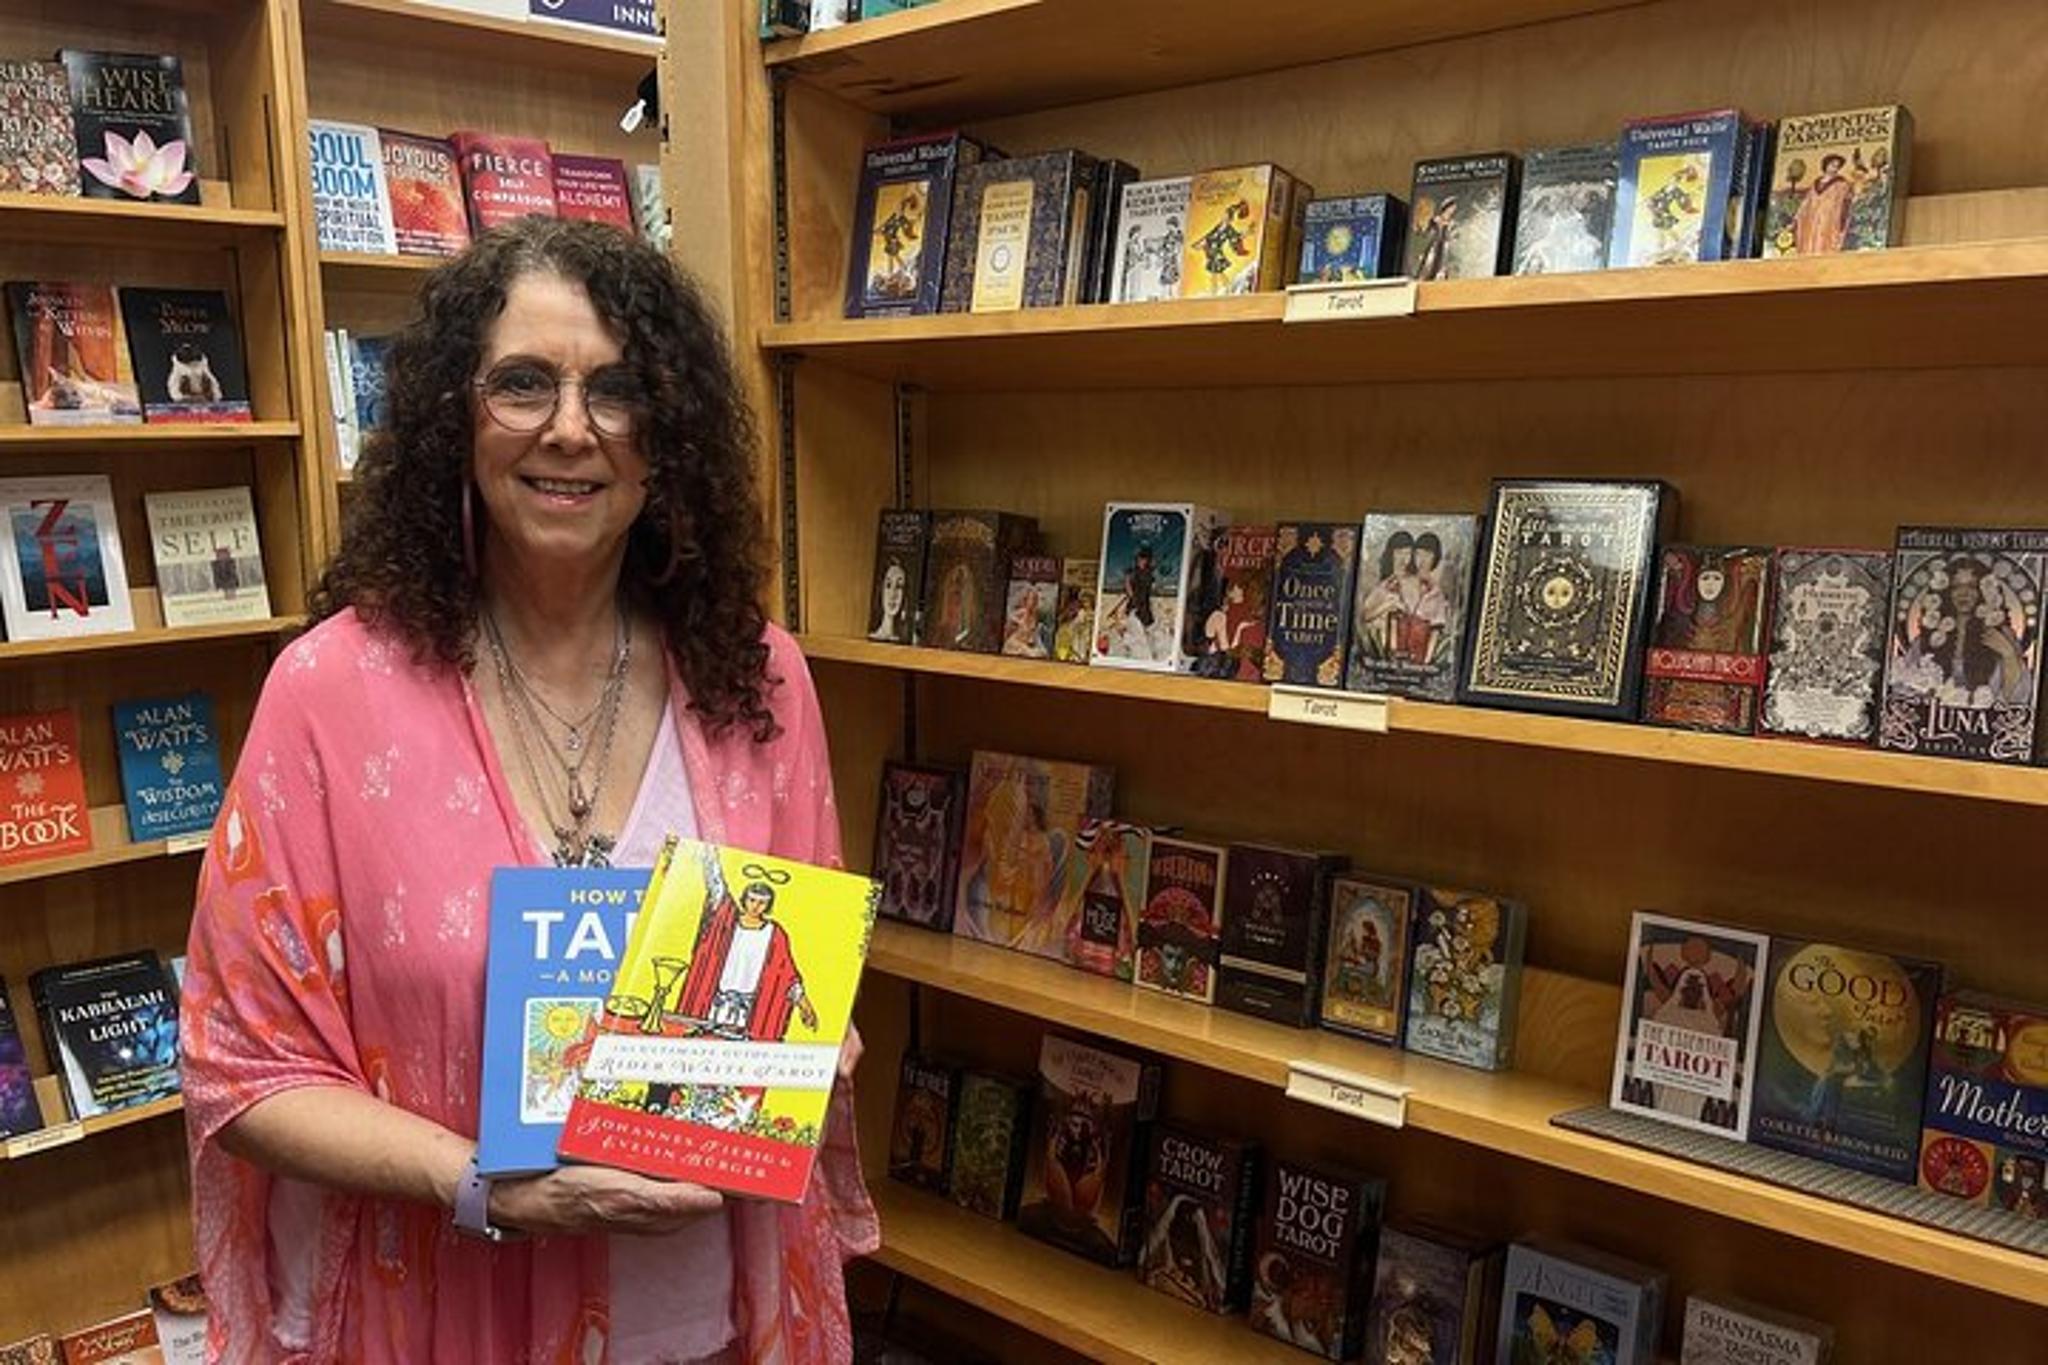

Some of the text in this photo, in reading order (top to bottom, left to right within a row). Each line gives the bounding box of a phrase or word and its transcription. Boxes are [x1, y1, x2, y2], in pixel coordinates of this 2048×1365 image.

[102, 67, 169, 92] WISE
[81, 87, 178, 112] HEART
[1785, 129, 1838, 145] TAROT
[1845, 124, 1889, 138] DECK
[472, 153, 544, 177] FIERCE
[559, 190, 622, 208] ALCHEMY
[1327, 294, 1364, 311] Tarot
[162, 526, 250, 556] SELF
[1522, 532, 1614, 548] TAROT
[1283, 576, 1335, 600] Once
[1276, 602, 1338, 631] Time
[136, 704, 192, 726] ALAN
[1303, 699, 1338, 718] Tarot
[1920, 697, 1990, 743] LUNA
[125, 722, 209, 751] WATTS
[136, 782, 217, 805] WISDOM
[11, 801, 47, 821] THE
[0, 802, 82, 851] BOOK
[571, 889, 627, 905] HOW
[579, 969, 619, 984] MO
[1789, 964, 1907, 1007] GOOD
[59, 990, 165, 1023] KABBALAH
[90, 1018, 148, 1042] LIGHT
[595, 1055, 827, 1079] RIDER WAITE TAROT
[1642, 1043, 1730, 1079] TAROT
[1330, 1085, 1365, 1108] Tarot
[576, 1115, 694, 1147] JOHANNES
[602, 1134, 676, 1162] EVELIN
[1162, 1136, 1224, 1171] CROW
[1160, 1154, 1226, 1192] TAROT
[1279, 1168, 1350, 1216] WISE
[1276, 1196, 1344, 1240] DOG
[1275, 1222, 1341, 1259] TAROT
[1700, 1310, 1802, 1358] PHANTASMA
